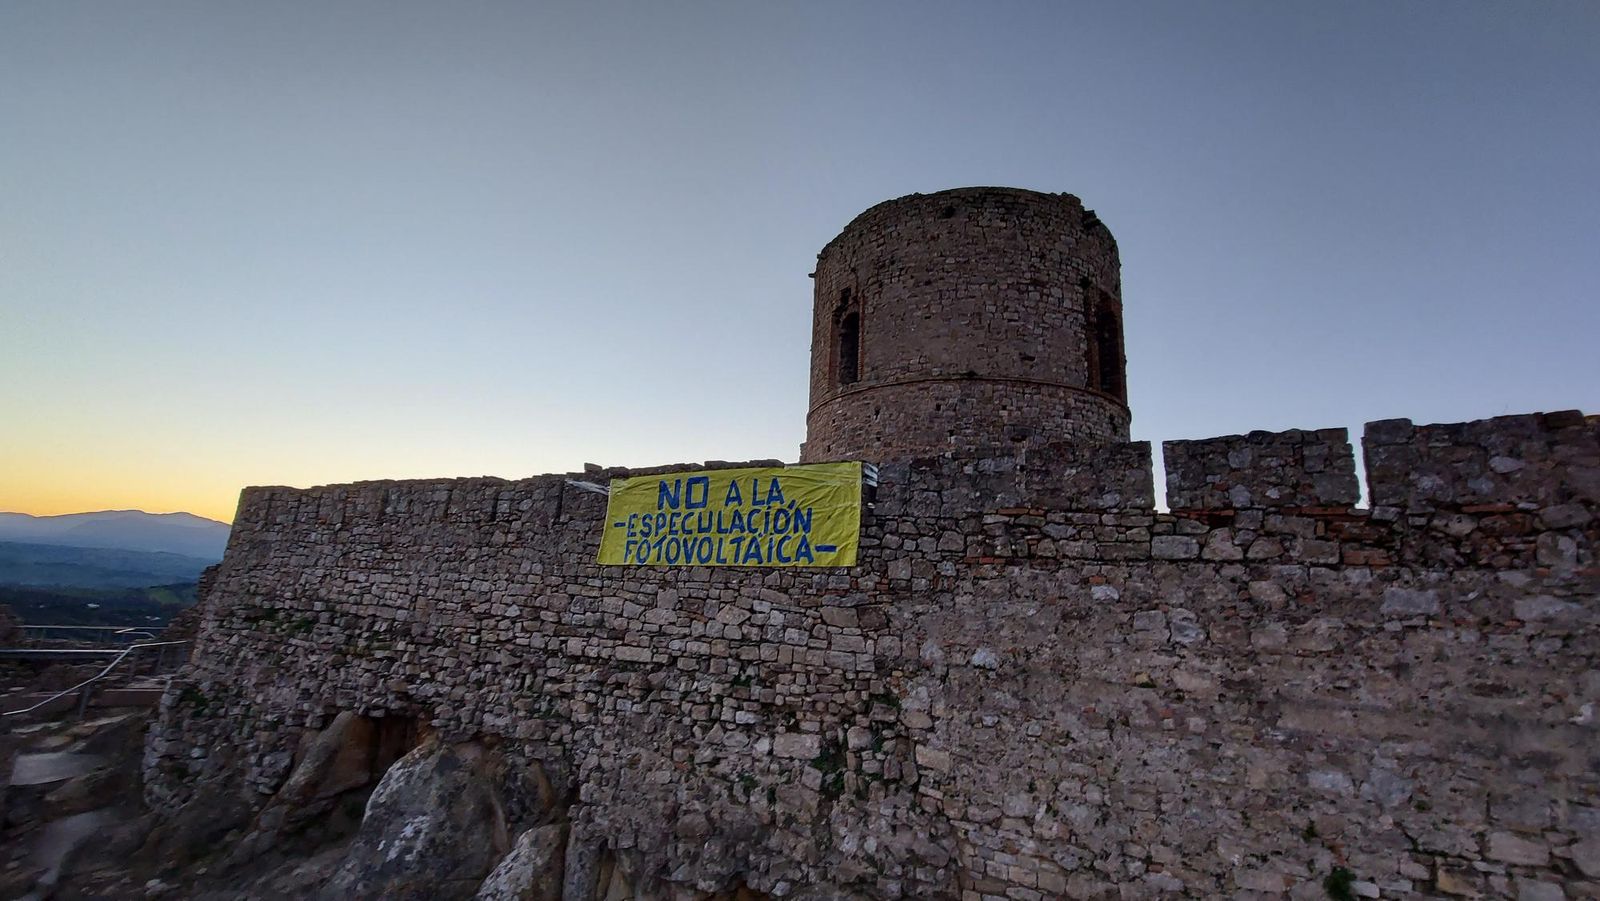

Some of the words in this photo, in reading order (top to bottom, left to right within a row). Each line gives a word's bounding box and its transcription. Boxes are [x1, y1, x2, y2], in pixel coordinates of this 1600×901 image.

[657, 476, 709, 510] NO
[724, 479, 743, 507] A
[751, 477, 785, 506] LA
